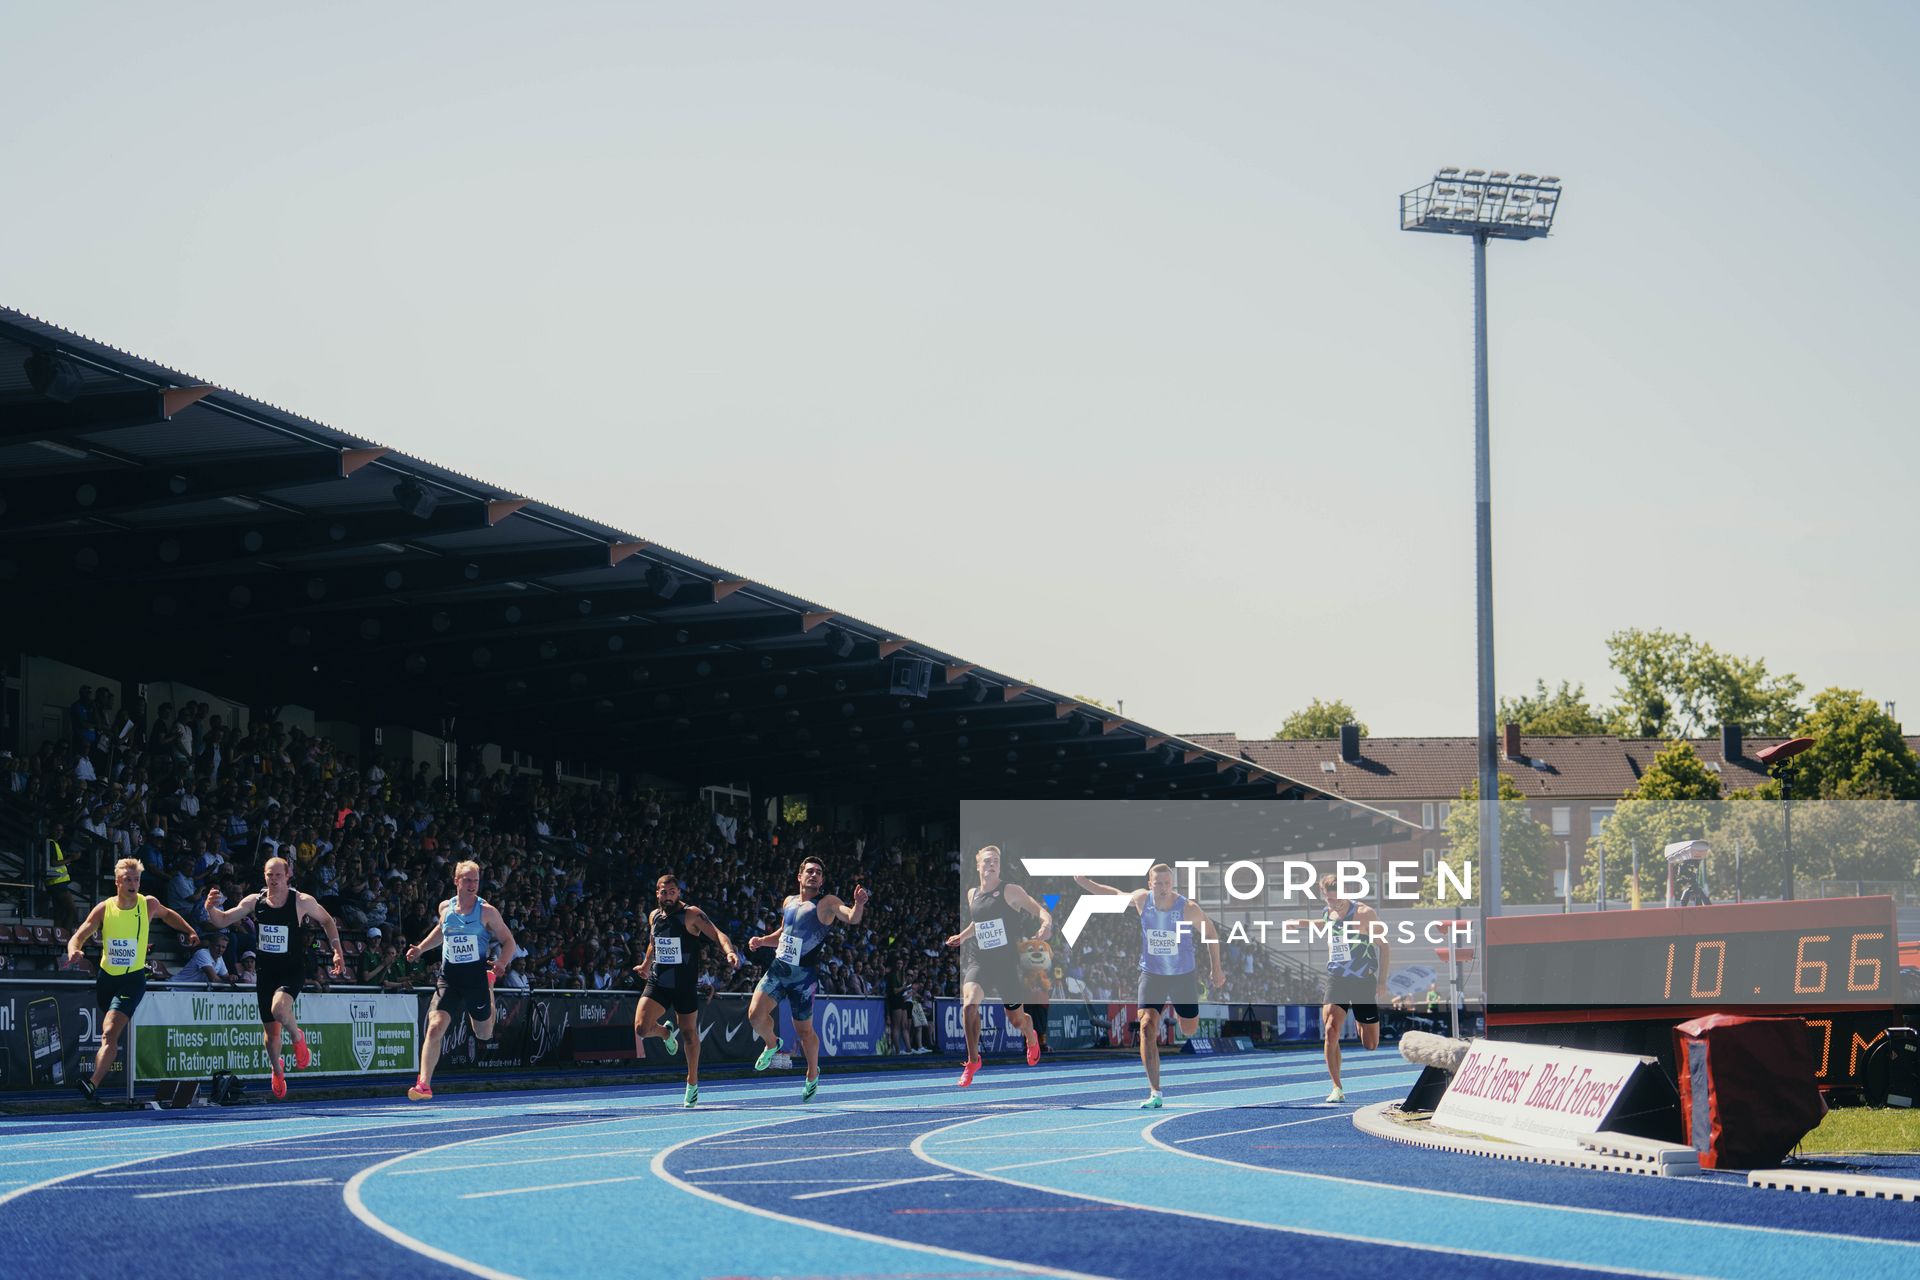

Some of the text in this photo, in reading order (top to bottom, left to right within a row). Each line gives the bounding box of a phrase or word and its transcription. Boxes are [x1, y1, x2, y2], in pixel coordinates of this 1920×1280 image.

[980, 921, 995, 930] GLS
[260, 934, 286, 944] WOLTER
[978, 928, 1003, 939] WOLFF
[112, 939, 128, 947] GLS
[1149, 938, 1176, 947] BECKERS
[108, 947, 136, 957] JANSONS
[452, 943, 474, 954] TAAM
[1663, 932, 1885, 999] 10.66
[192, 997, 214, 1021] Wir
[842, 1008, 869, 1035] PLAN
[167, 1028, 208, 1048] Fitness-
[210, 1027, 228, 1046] und
[842, 1041, 869, 1050] INTERNATIONAL
[167, 1052, 177, 1072] in
[179, 1051, 224, 1075] Ratingen
[227, 1050, 250, 1069] Mitte
[253, 1049, 259, 1069] &
[1452, 1052, 1624, 1118] Black Forest Black Forest
